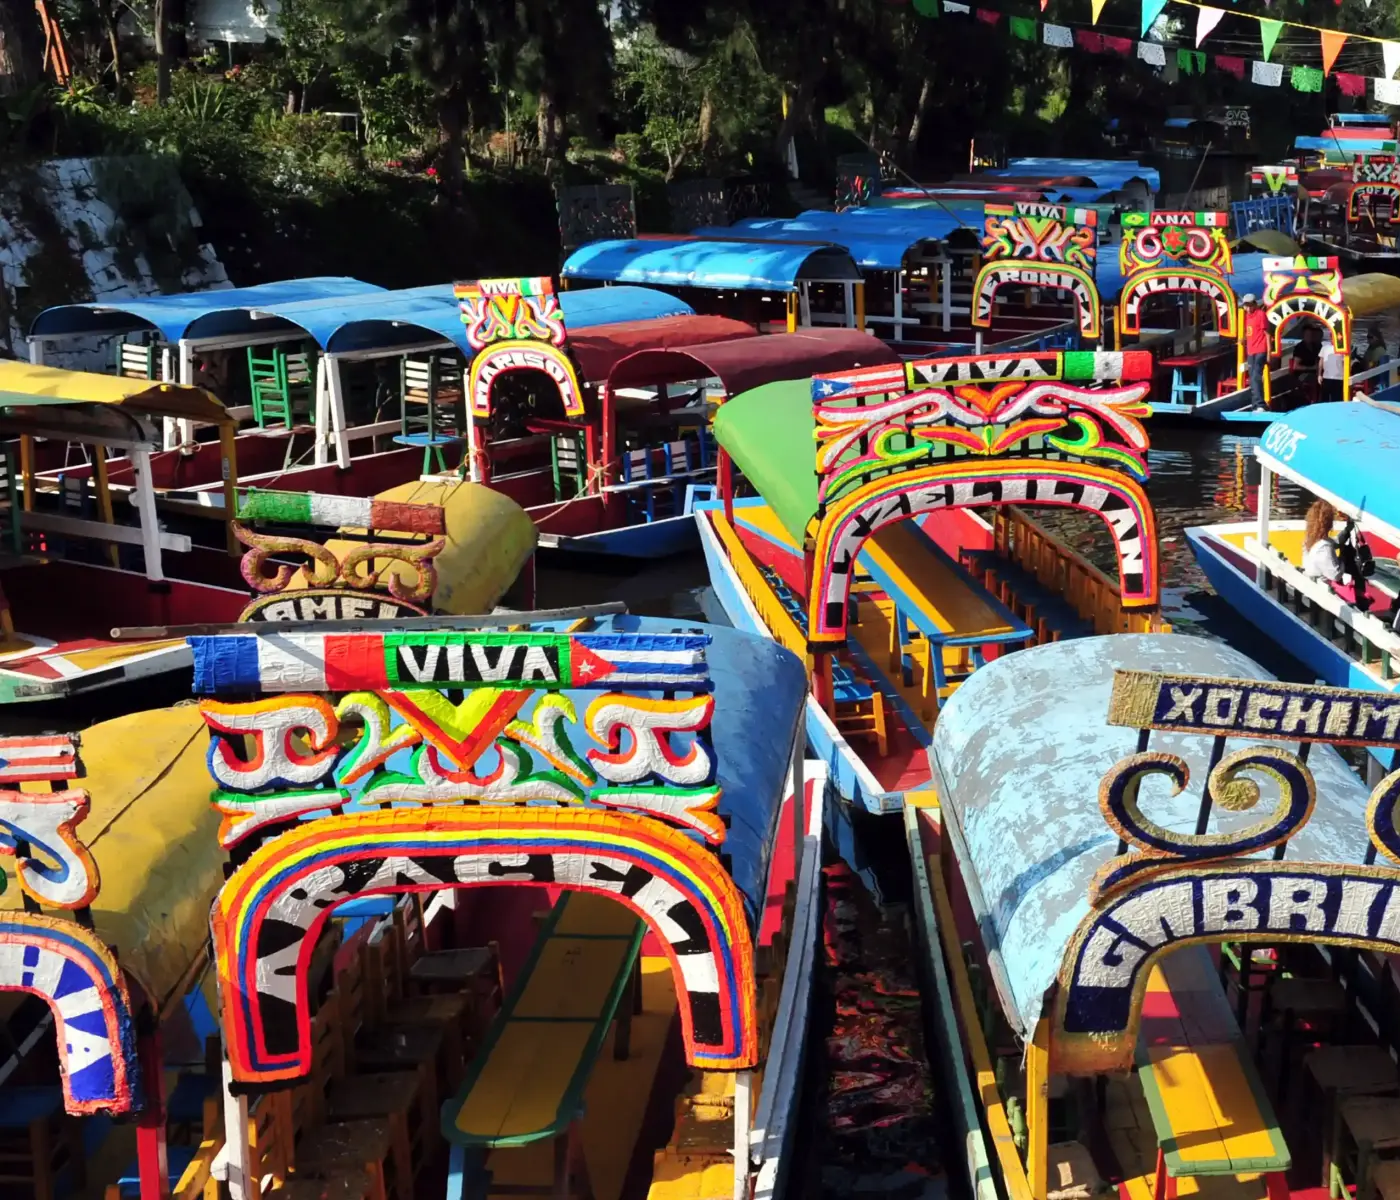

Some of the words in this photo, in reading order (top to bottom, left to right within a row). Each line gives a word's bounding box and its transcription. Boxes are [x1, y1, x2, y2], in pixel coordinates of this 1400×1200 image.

[1017, 203, 1060, 219] VIVA
[1153, 215, 1193, 225] ANA
[480, 281, 519, 294] VIVA
[978, 270, 1092, 330] VERONICA
[1127, 277, 1228, 316] LILIANA
[1267, 298, 1343, 327] DAFNE
[477, 352, 573, 407] MARISOL
[913, 358, 1047, 384] VIVA
[398, 643, 559, 684] VIVA
[256, 853, 722, 1004] ARACELI
